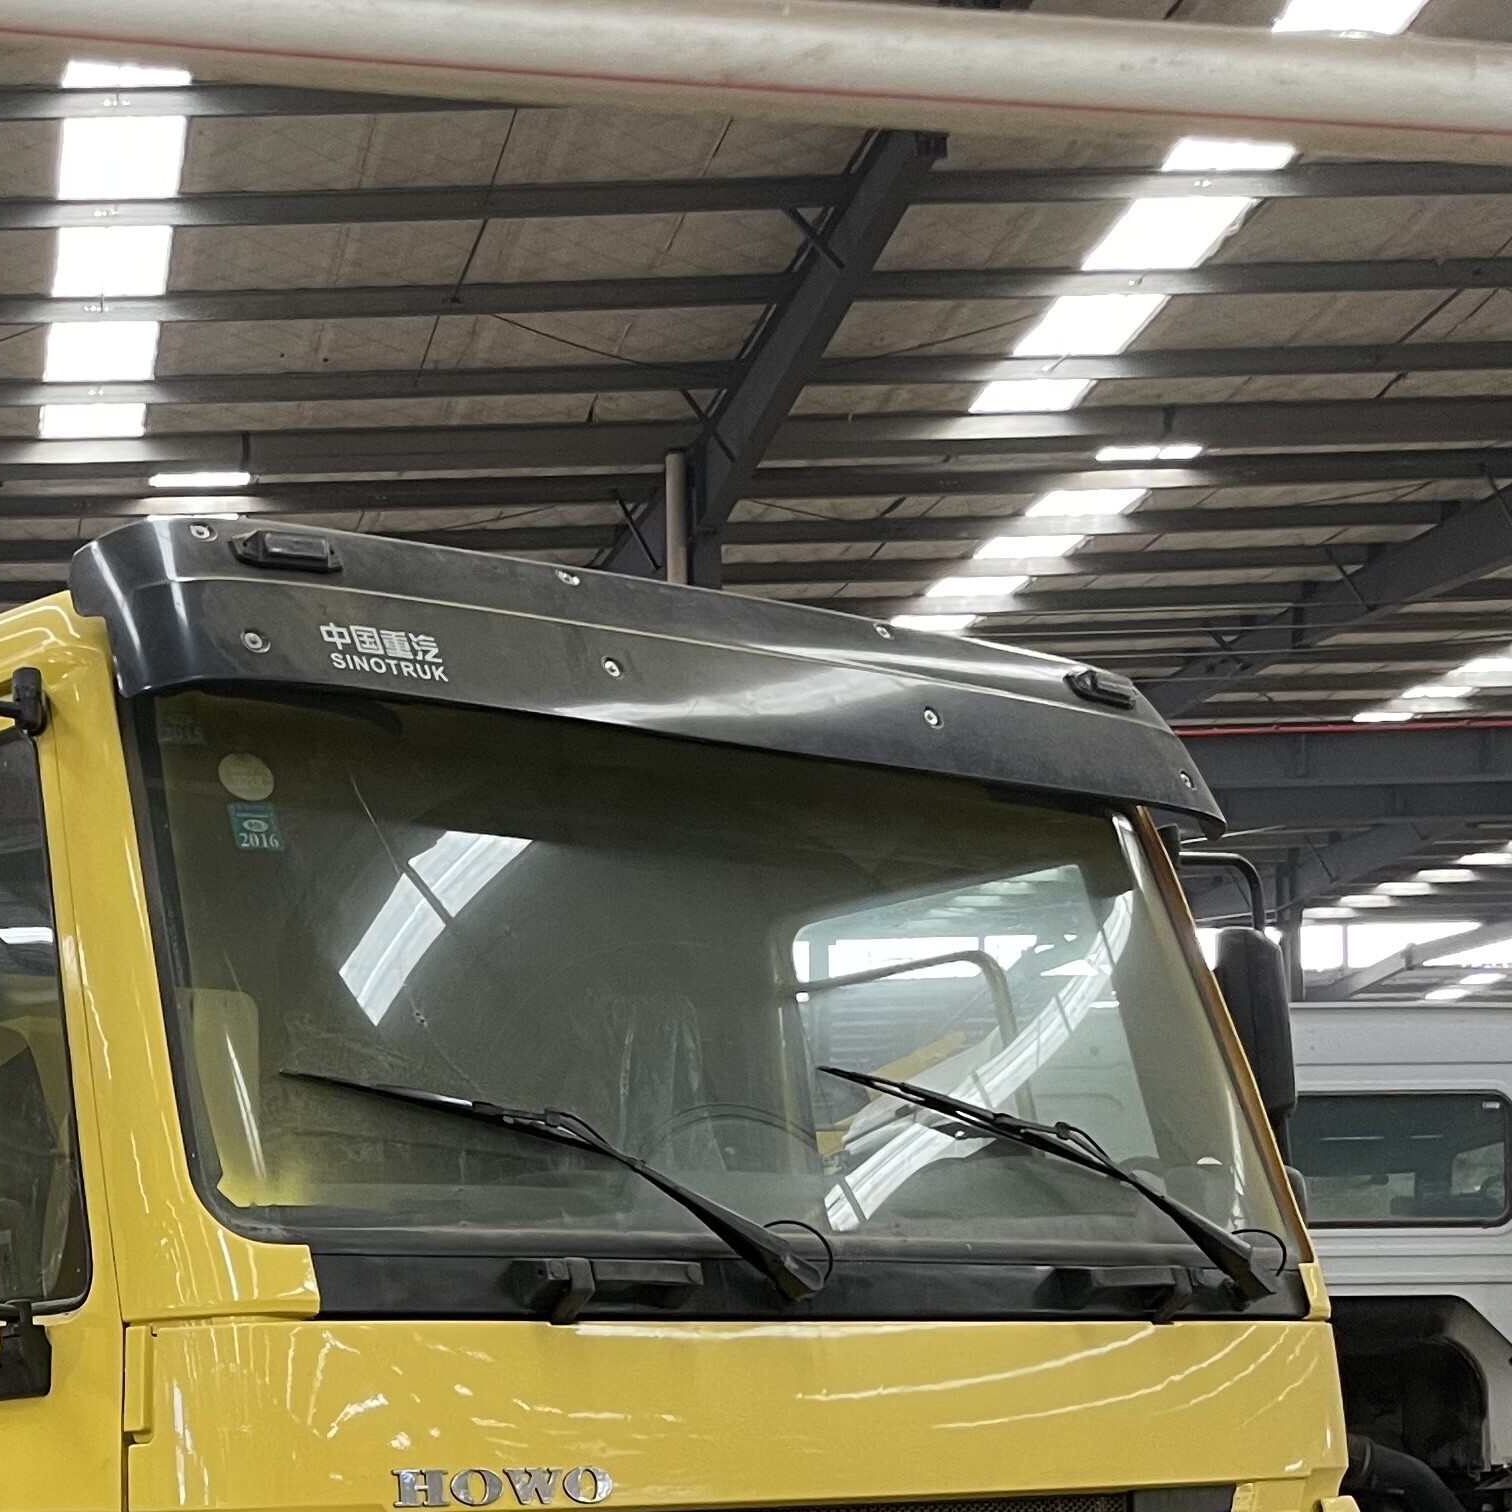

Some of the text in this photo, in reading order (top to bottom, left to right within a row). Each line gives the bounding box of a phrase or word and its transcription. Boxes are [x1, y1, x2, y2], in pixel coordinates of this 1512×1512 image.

[320, 622, 442, 663] 中国重汽
[330, 653, 448, 682] SINOTRUK
[239, 833, 280, 848] 2016
[391, 1465, 613, 1507] HOWO
